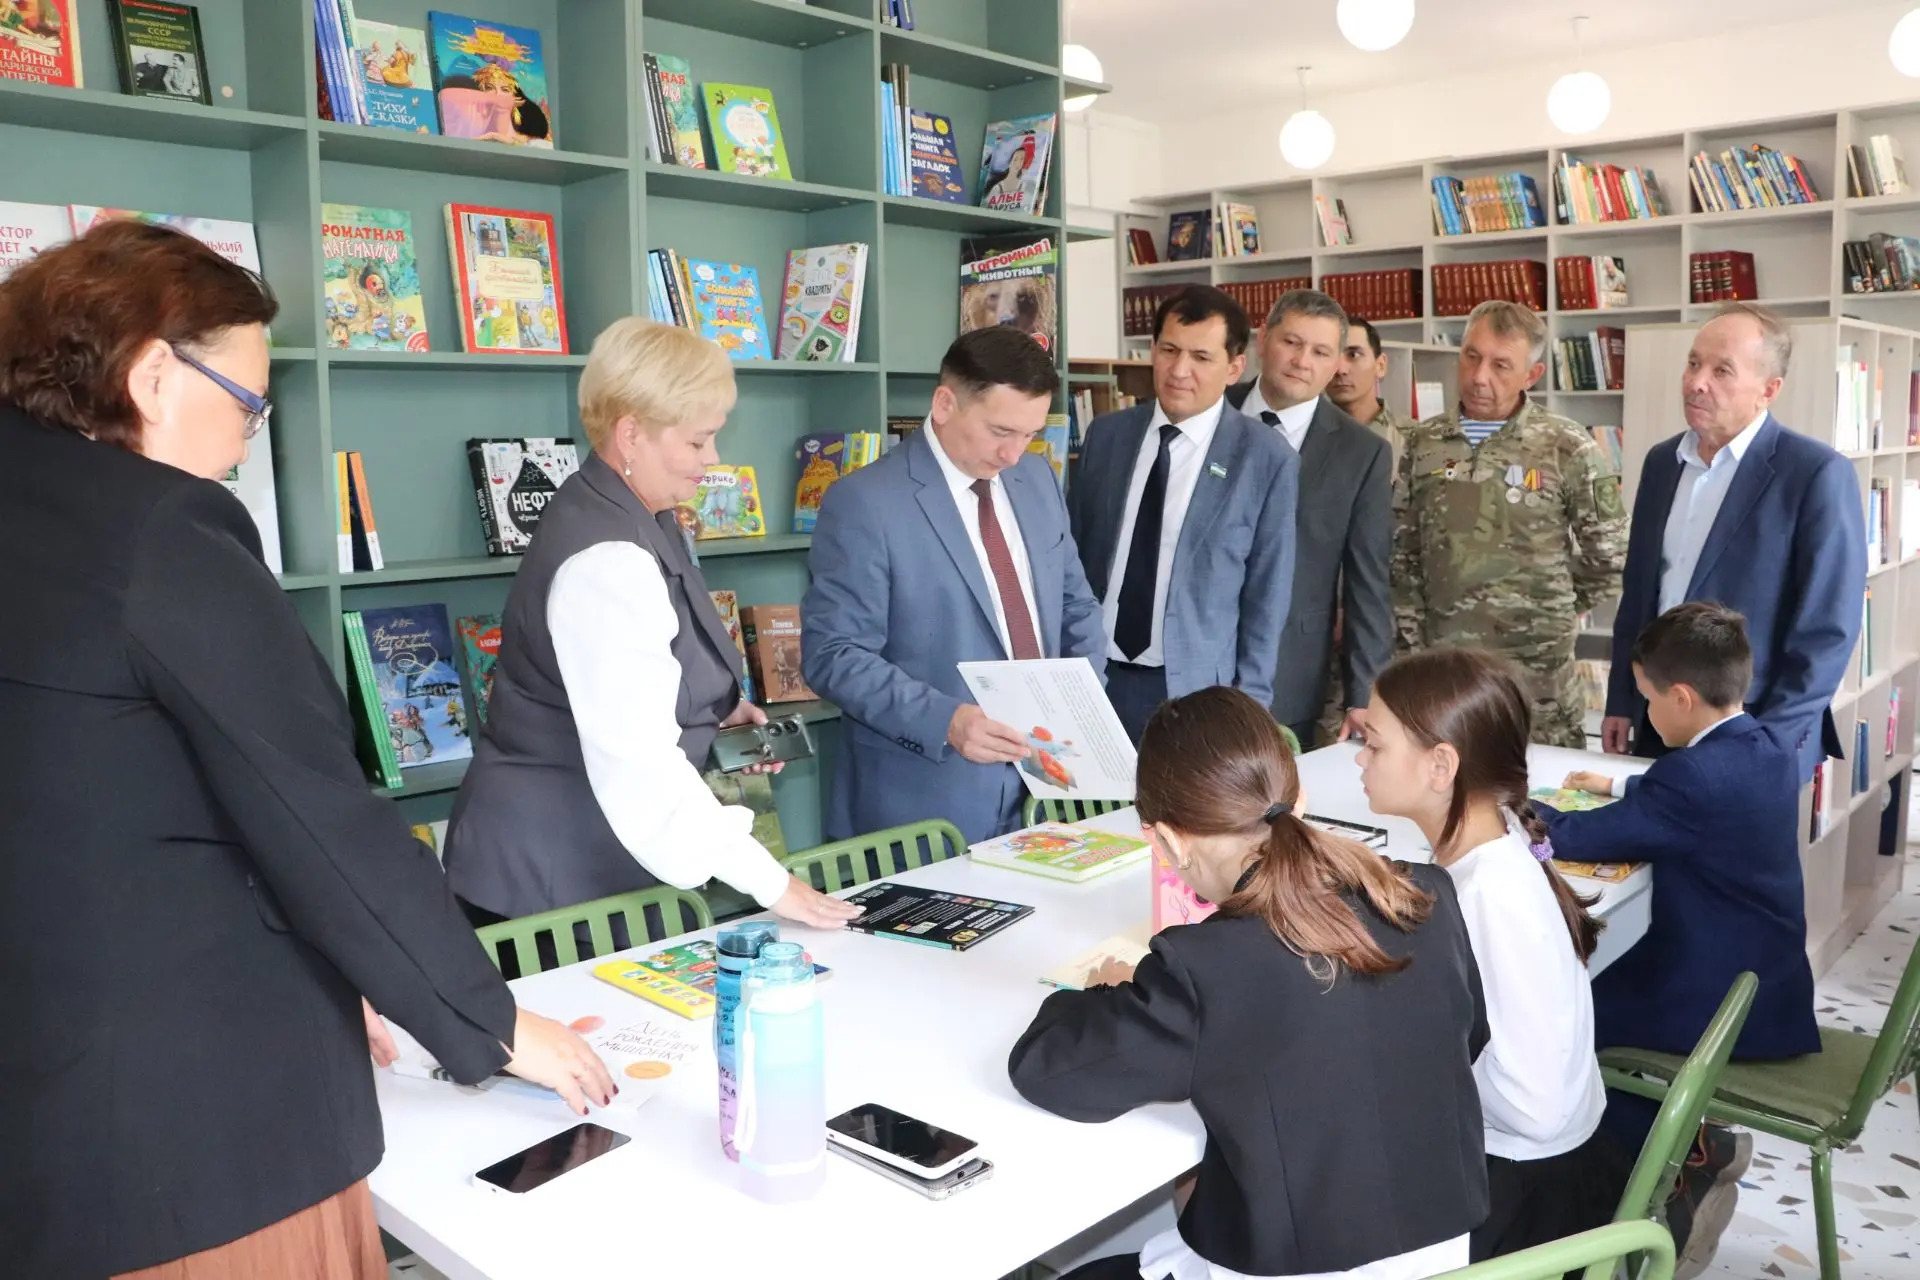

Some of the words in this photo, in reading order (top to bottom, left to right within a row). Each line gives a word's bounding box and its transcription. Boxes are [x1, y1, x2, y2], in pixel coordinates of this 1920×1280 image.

[147, 27, 171, 36] СССР
[2, 48, 56, 68] ТАЙНЫ
[0, 60, 62, 77] АРИЖСКОЙ
[977, 242, 1043, 273] ОГРОМНАЯ
[978, 265, 1044, 282] ЖИВОТНЫЕ
[805, 283, 832, 296] КВАДРАТЫ
[599, 1040, 684, 1061] МЫШОНКА
